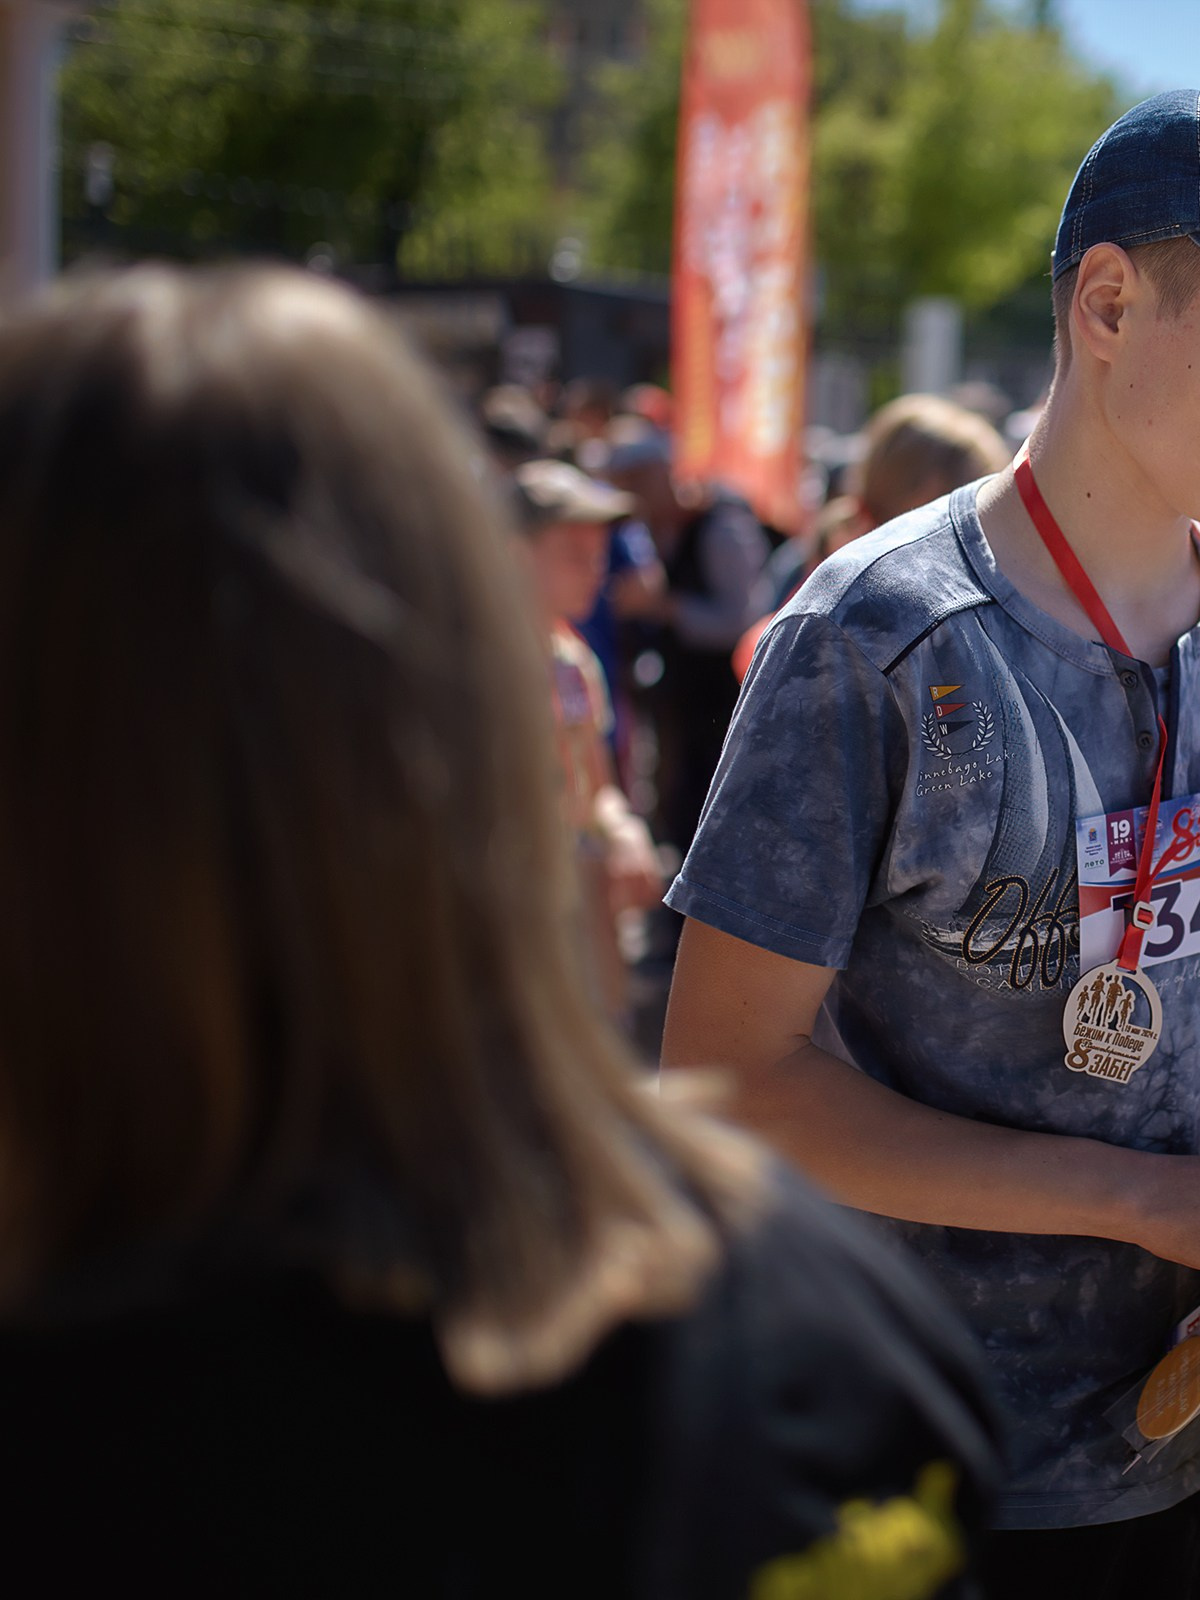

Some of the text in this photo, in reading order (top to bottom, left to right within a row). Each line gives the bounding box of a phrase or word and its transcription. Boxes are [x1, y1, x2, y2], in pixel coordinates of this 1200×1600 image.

[932, 686, 939, 697] R
[940, 723, 948, 735] W
[985, 750, 1016, 765] Lake
[916, 769, 993, 797] Green Lake
[1110, 819, 1130, 839] 19
[1073, 1022, 1145, 1053] Бежим к Победе
[1066, 1038, 1136, 1081] 8 ЗАБЕГ
